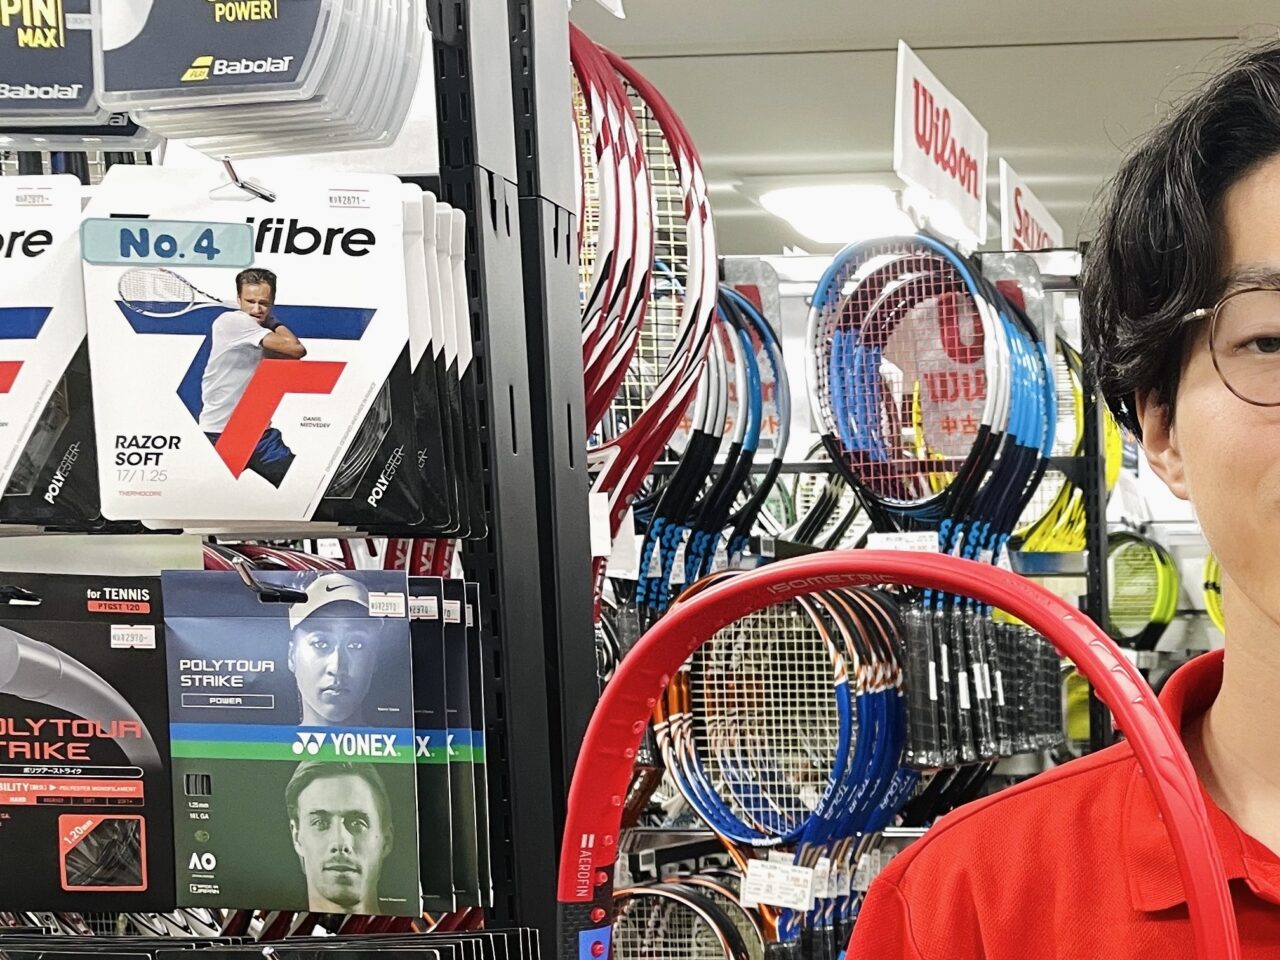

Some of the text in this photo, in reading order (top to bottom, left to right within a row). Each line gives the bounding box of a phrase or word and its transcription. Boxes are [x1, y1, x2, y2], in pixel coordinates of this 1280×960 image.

[215, 2, 272, 22] POWER
[17, 28, 58, 48] MAX
[912, 78, 980, 200] Wilson
[115, 435, 181, 449] RAZOR
[115, 452, 164, 466] SOFT
[44, 441, 81, 506] POLYESTER
[368, 444, 405, 508] POLYESTER
[87, 587, 150, 601] for TENNIS
[766, 574, 896, 594] ISOMETRIC
[126, 603, 141, 611] 120
[180, 660, 275, 672] POLYTOUR
[181, 675, 244, 687] STRIKE
[209, 696, 243, 705] POWER
[330, 732, 397, 757] YONEX
[815, 776, 837, 817] TOUR
[63, 819, 95, 845] 1.20mm
[576, 850, 592, 898] AEROFIN
